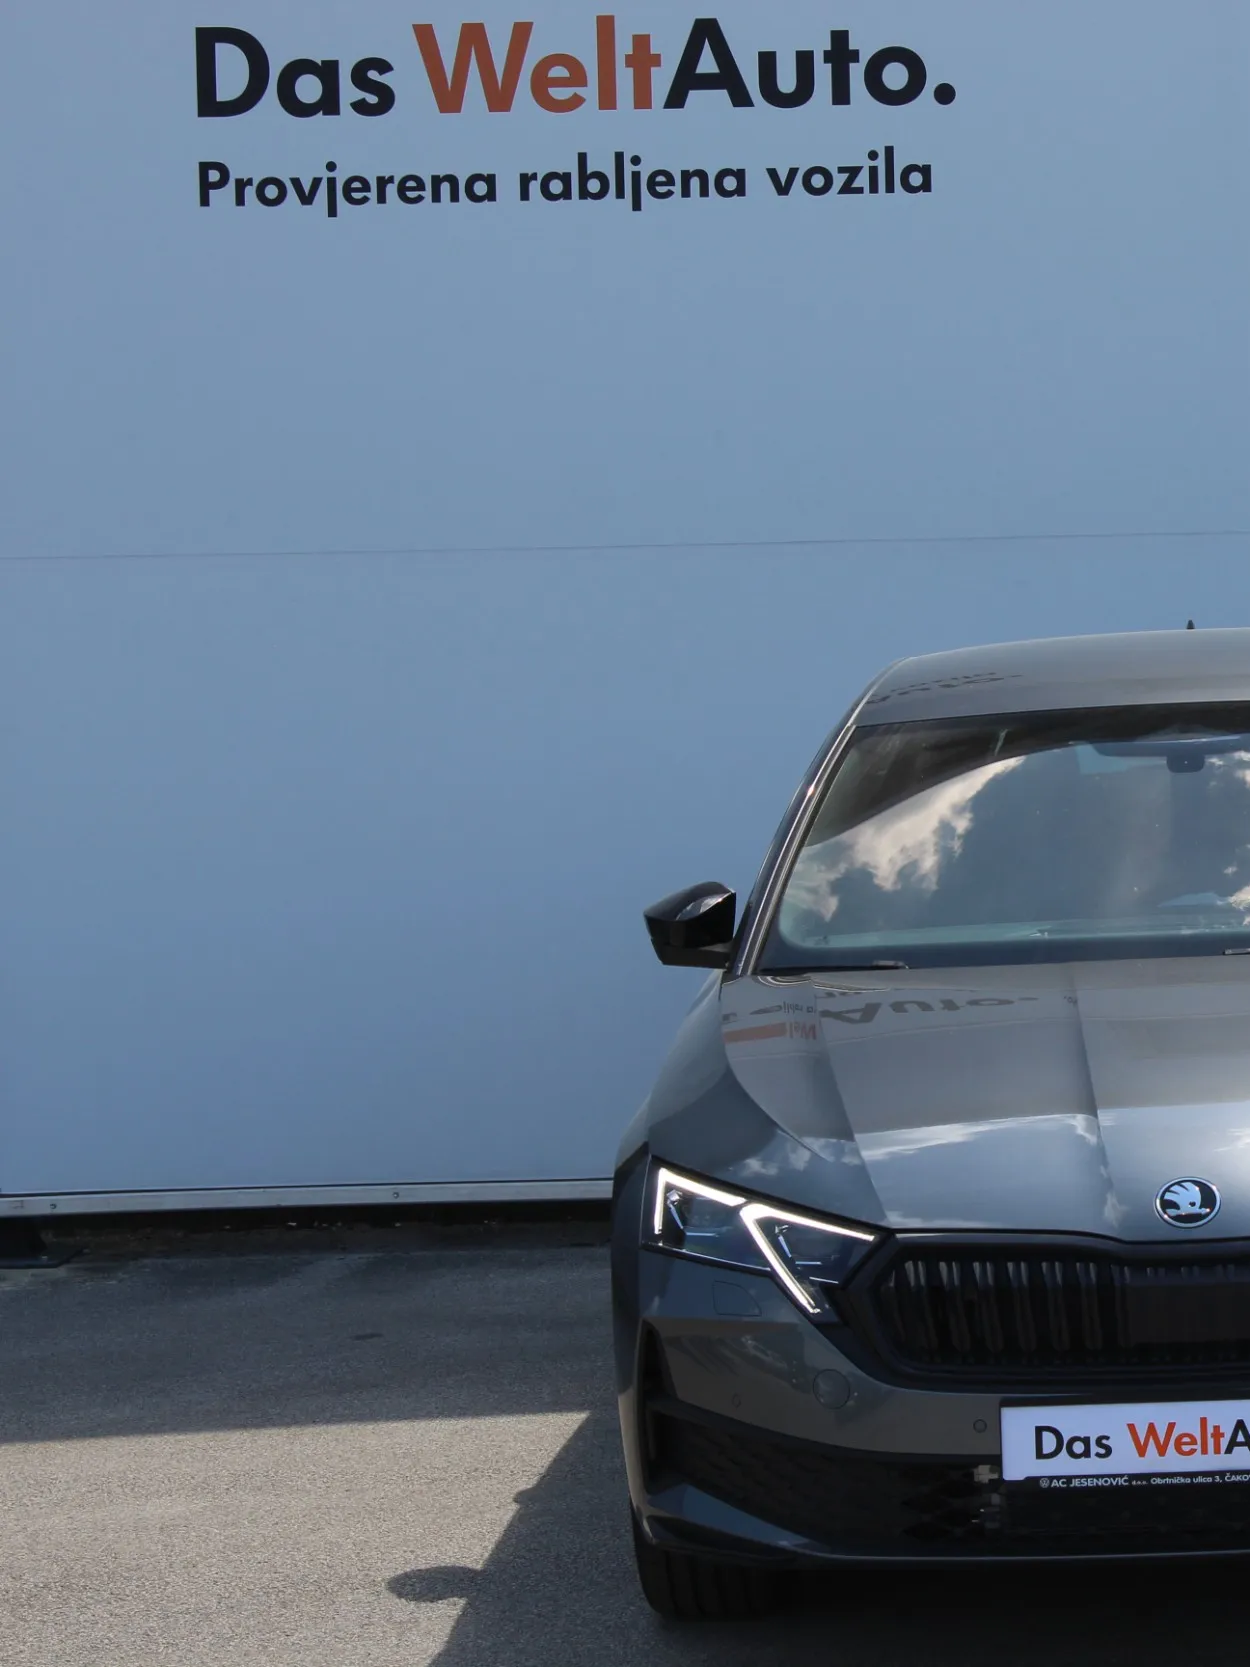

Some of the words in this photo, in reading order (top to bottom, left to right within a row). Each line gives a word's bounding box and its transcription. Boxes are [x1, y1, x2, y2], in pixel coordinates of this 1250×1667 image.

[195, 26, 396, 119] Das
[412, 14, 957, 114] WeltAuto.
[198, 160, 498, 218] Provjerena
[519, 151, 747, 212] rabljena
[765, 145, 933, 197] vozila
[1034, 1425, 1113, 1460] Das
[1050, 1478, 1067, 1488] AC
[1069, 1474, 1130, 1488] JESENOVIĆ
[1150, 1476, 1191, 1485] Obrtnička
[1192, 1475, 1213, 1483] ulica
[1214, 1475, 1223, 1484] 3,
